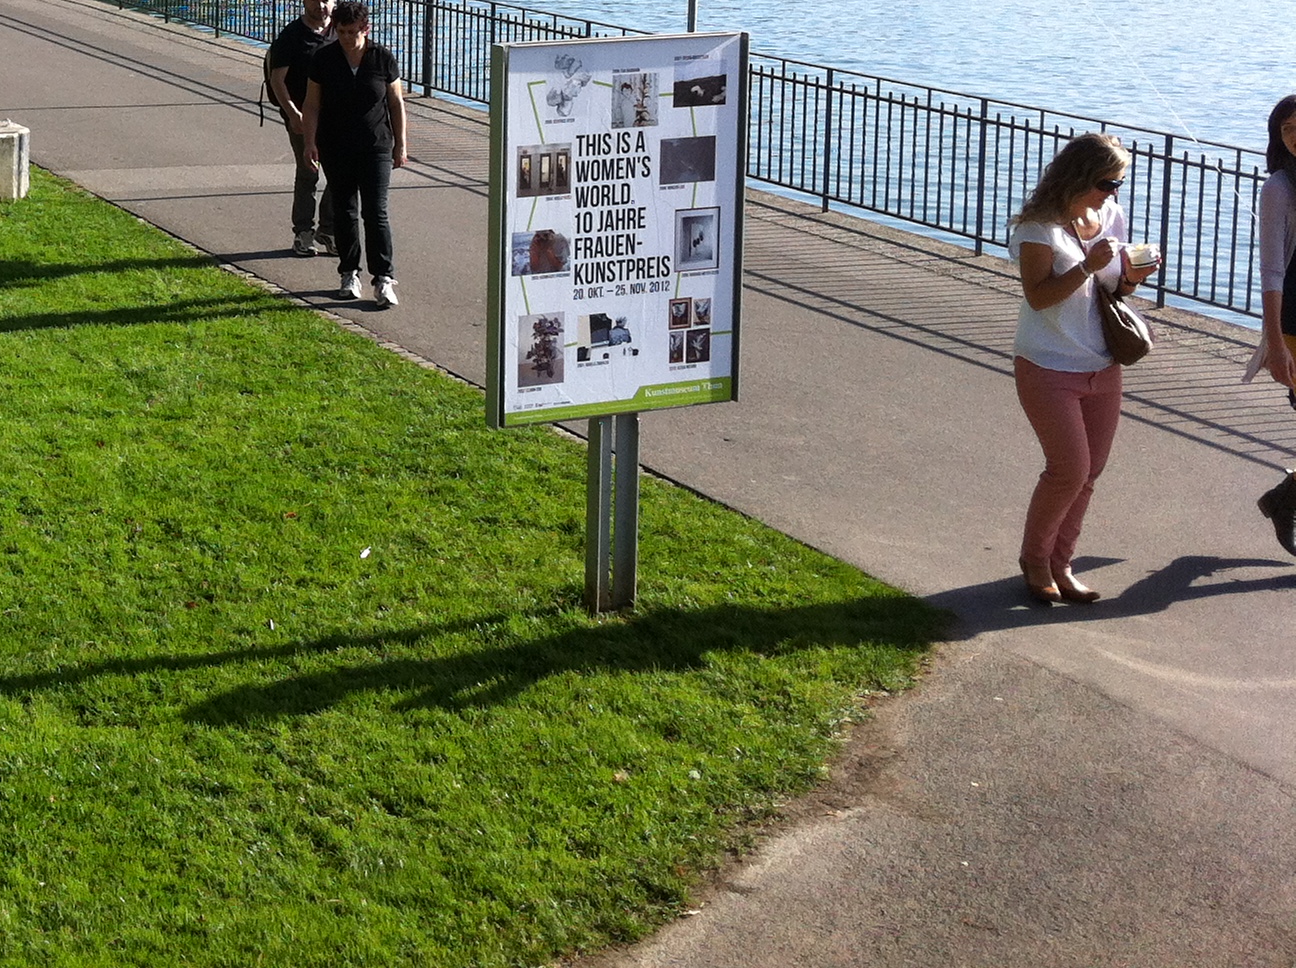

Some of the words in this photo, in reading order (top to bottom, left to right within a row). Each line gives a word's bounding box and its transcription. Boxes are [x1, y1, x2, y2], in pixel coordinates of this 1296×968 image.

[576, 133, 611, 156] THIS
[617, 132, 631, 154] IS
[635, 131, 645, 152] A
[576, 156, 651, 182] WOMEN'S
[575, 211, 593, 234] 10
[597, 207, 646, 232] JAHRE
[574, 233, 643, 259] FRAUEN-
[574, 255, 671, 285] KUNSTPREIS
[573, 288, 585, 300] 20.
[588, 286, 604, 299] OKT.
[630, 282, 647, 295] NOV.
[649, 280, 670, 293] 2012
